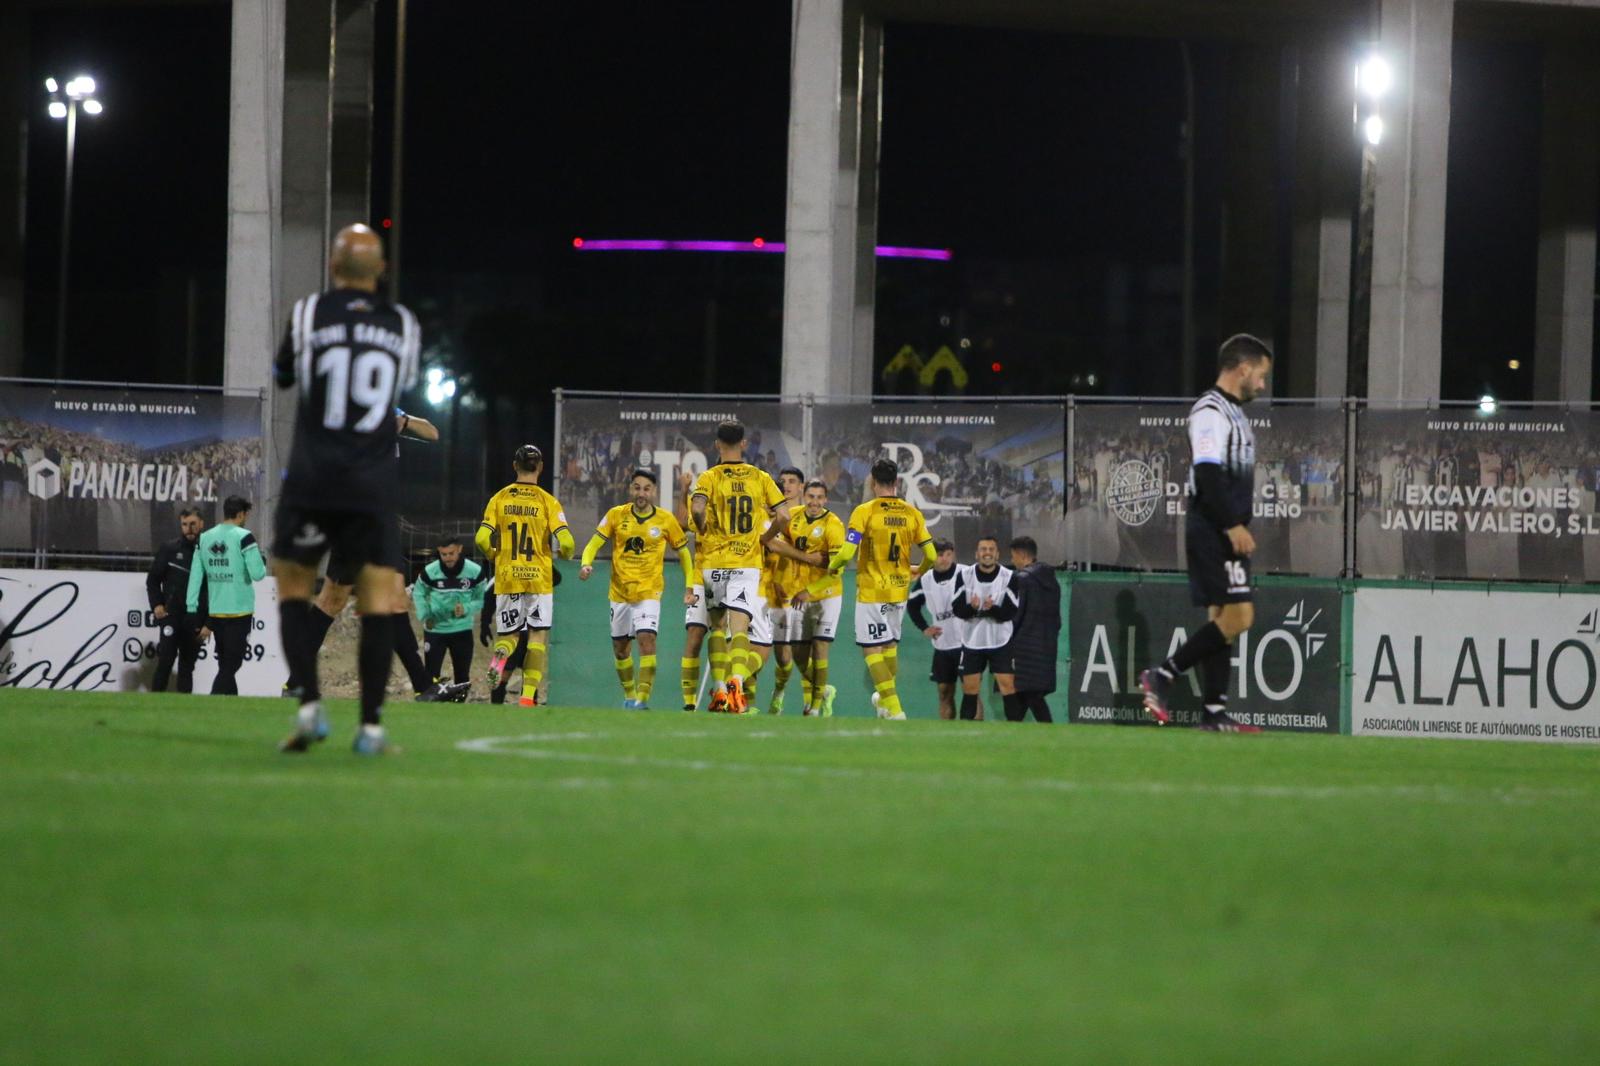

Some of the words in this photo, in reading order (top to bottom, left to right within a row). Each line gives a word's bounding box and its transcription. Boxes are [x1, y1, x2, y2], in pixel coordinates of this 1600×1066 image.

[315, 345, 396, 433] 19
[54, 401, 89, 411] NUEVO
[92, 402, 137, 413] ESTADIO
[140, 404, 197, 415] MUNICIPAL
[620, 411, 648, 420] NUEVO
[650, 411, 688, 421] ESTADIO
[689, 412, 737, 422] MUNICIPAL
[872, 415, 901, 424] NUEVO
[904, 415, 943, 425] ESTADIO
[945, 415, 996, 425] MUNICIPAL
[1140, 417, 1171, 426] NUEVO
[1427, 420, 1460, 431] NUEVO
[1463, 421, 1505, 431] ESTADIO
[1509, 422, 1565, 432] MUNICIPAL
[68, 461, 188, 502] PANIAGUA
[194, 478, 218, 502] S.L.
[1405, 484, 1581, 509] EXCAVACIONES
[727, 495, 753, 535] 18
[1166, 500, 1187, 515] EL
[1381, 508, 1459, 532] JAVIER
[1464, 511, 1562, 538] VALERO,
[508, 521, 535, 562] 14
[848, 532, 855, 541] C
[888, 532, 901, 568] 4
[1225, 561, 1247, 585] 16
[1364, 634, 1597, 711] ALAHO
[1078, 705, 1136, 721] ASOCIACIÓN
[1253, 712, 1266, 726] DE
[1268, 711, 1328, 728] HOSTELERÍA
[1362, 716, 1420, 732] ASOCIACIÓN
[1423, 719, 1463, 734] LINENSE
[1465, 721, 1479, 734] DE
[1480, 719, 1542, 737] AUTÓNOMOS
[1545, 724, 1558, 737] DE
